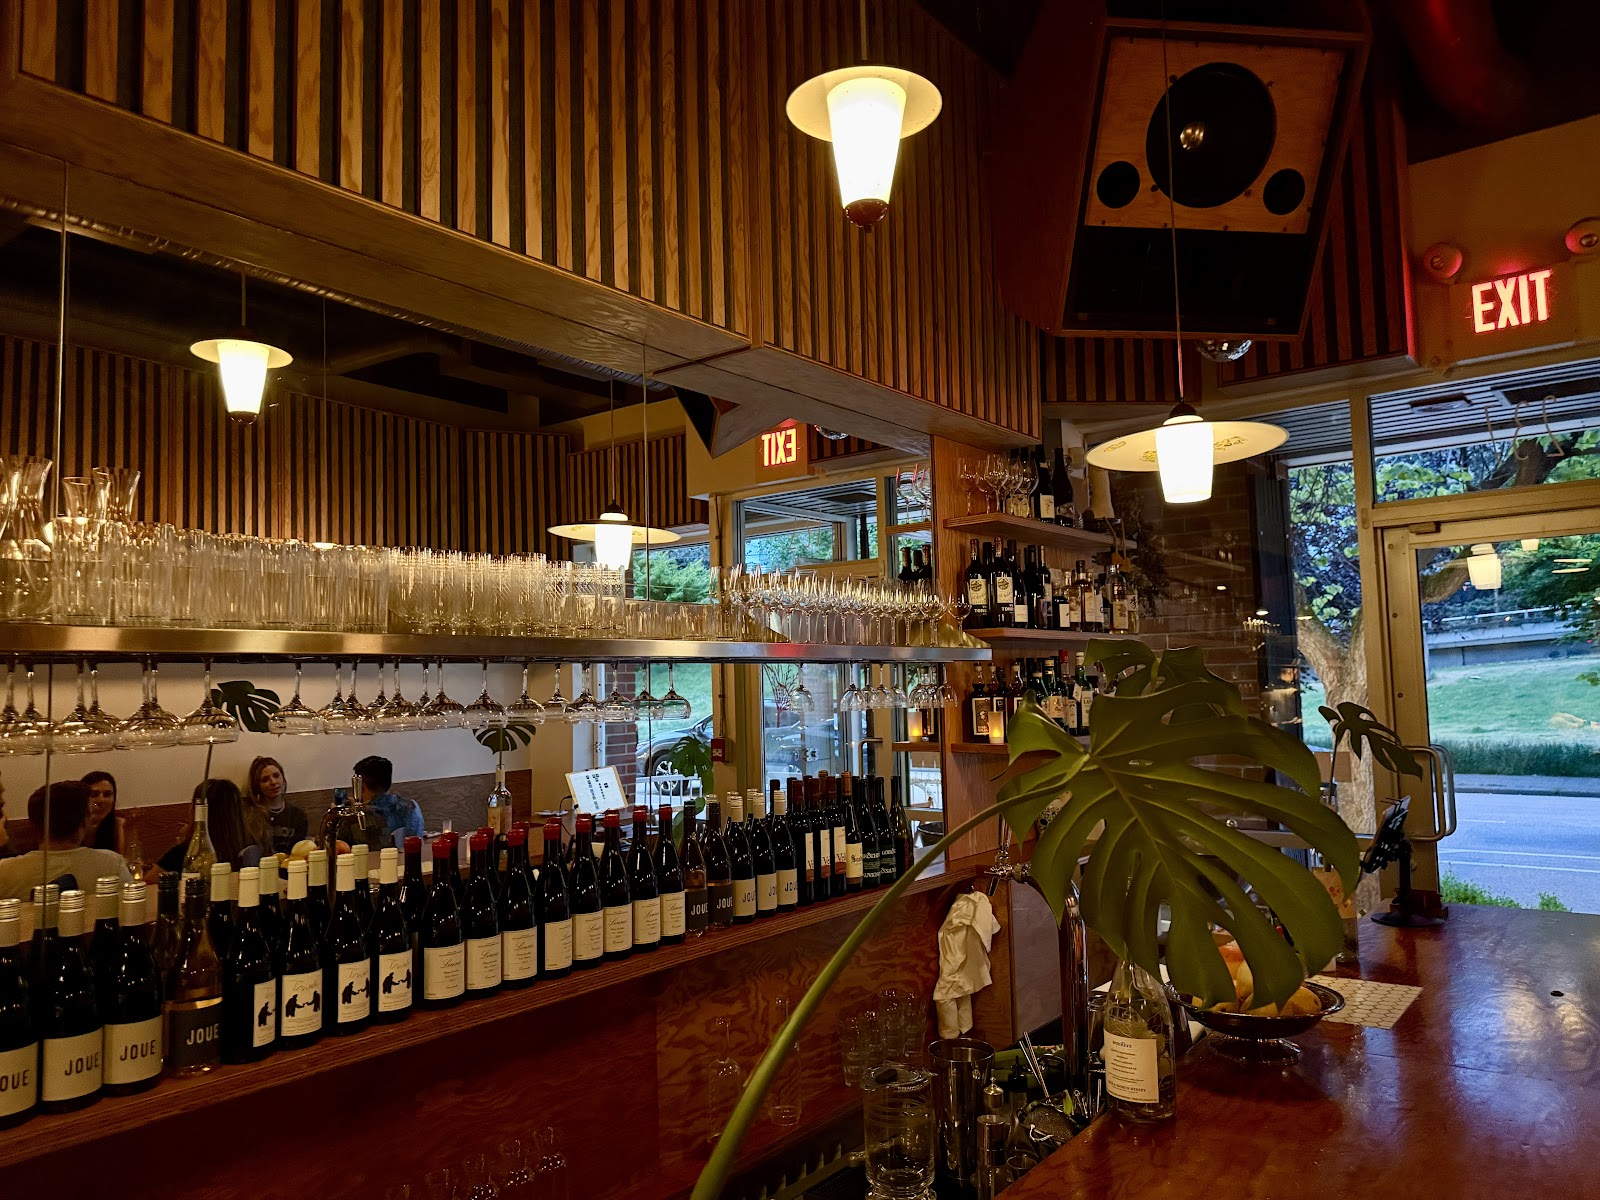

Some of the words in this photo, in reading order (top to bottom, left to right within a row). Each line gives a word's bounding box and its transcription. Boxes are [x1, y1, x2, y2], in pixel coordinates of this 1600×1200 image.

[1472, 269, 1552, 333] EXIT
[691, 902, 708, 916] JOUE
[186, 1023, 220, 1046] JOUE
[120, 1039, 156, 1061] JOUE
[64, 1051, 100, 1076] JOUE
[0, 1069, 30, 1092] OUE
